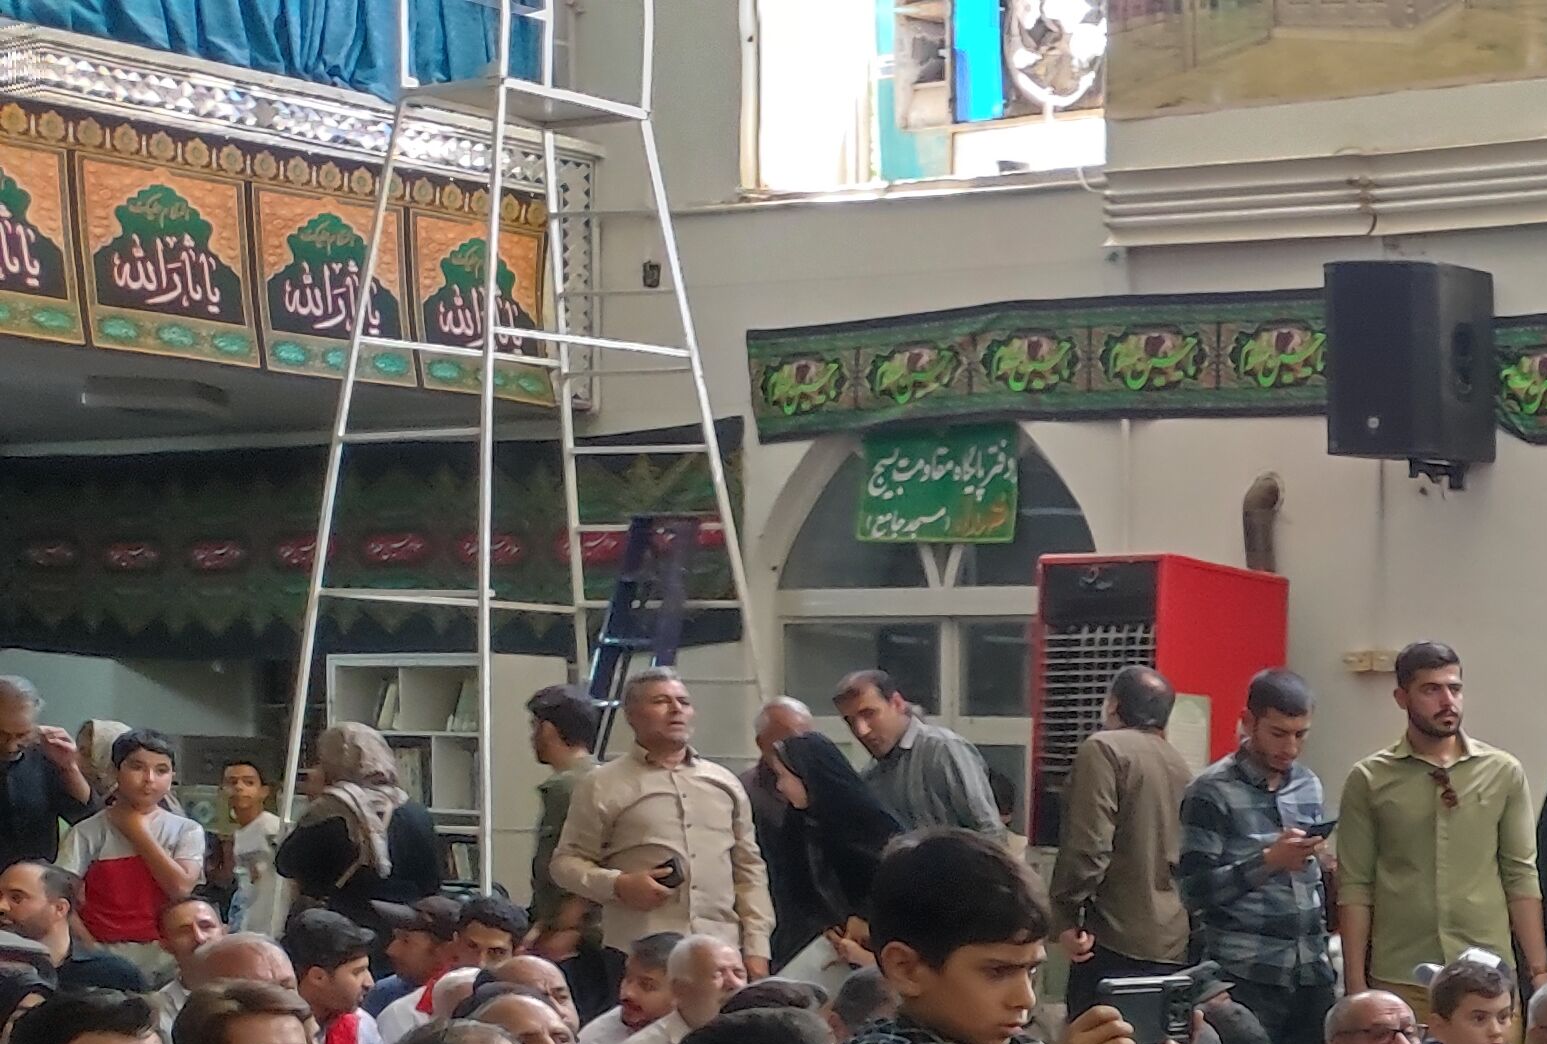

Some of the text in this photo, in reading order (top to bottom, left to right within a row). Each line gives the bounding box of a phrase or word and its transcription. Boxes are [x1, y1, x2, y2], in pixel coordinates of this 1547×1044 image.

[199, 252, 221, 314] یا
[867, 439, 1018, 502] دفتر پایگاه مقاومت بسیج
